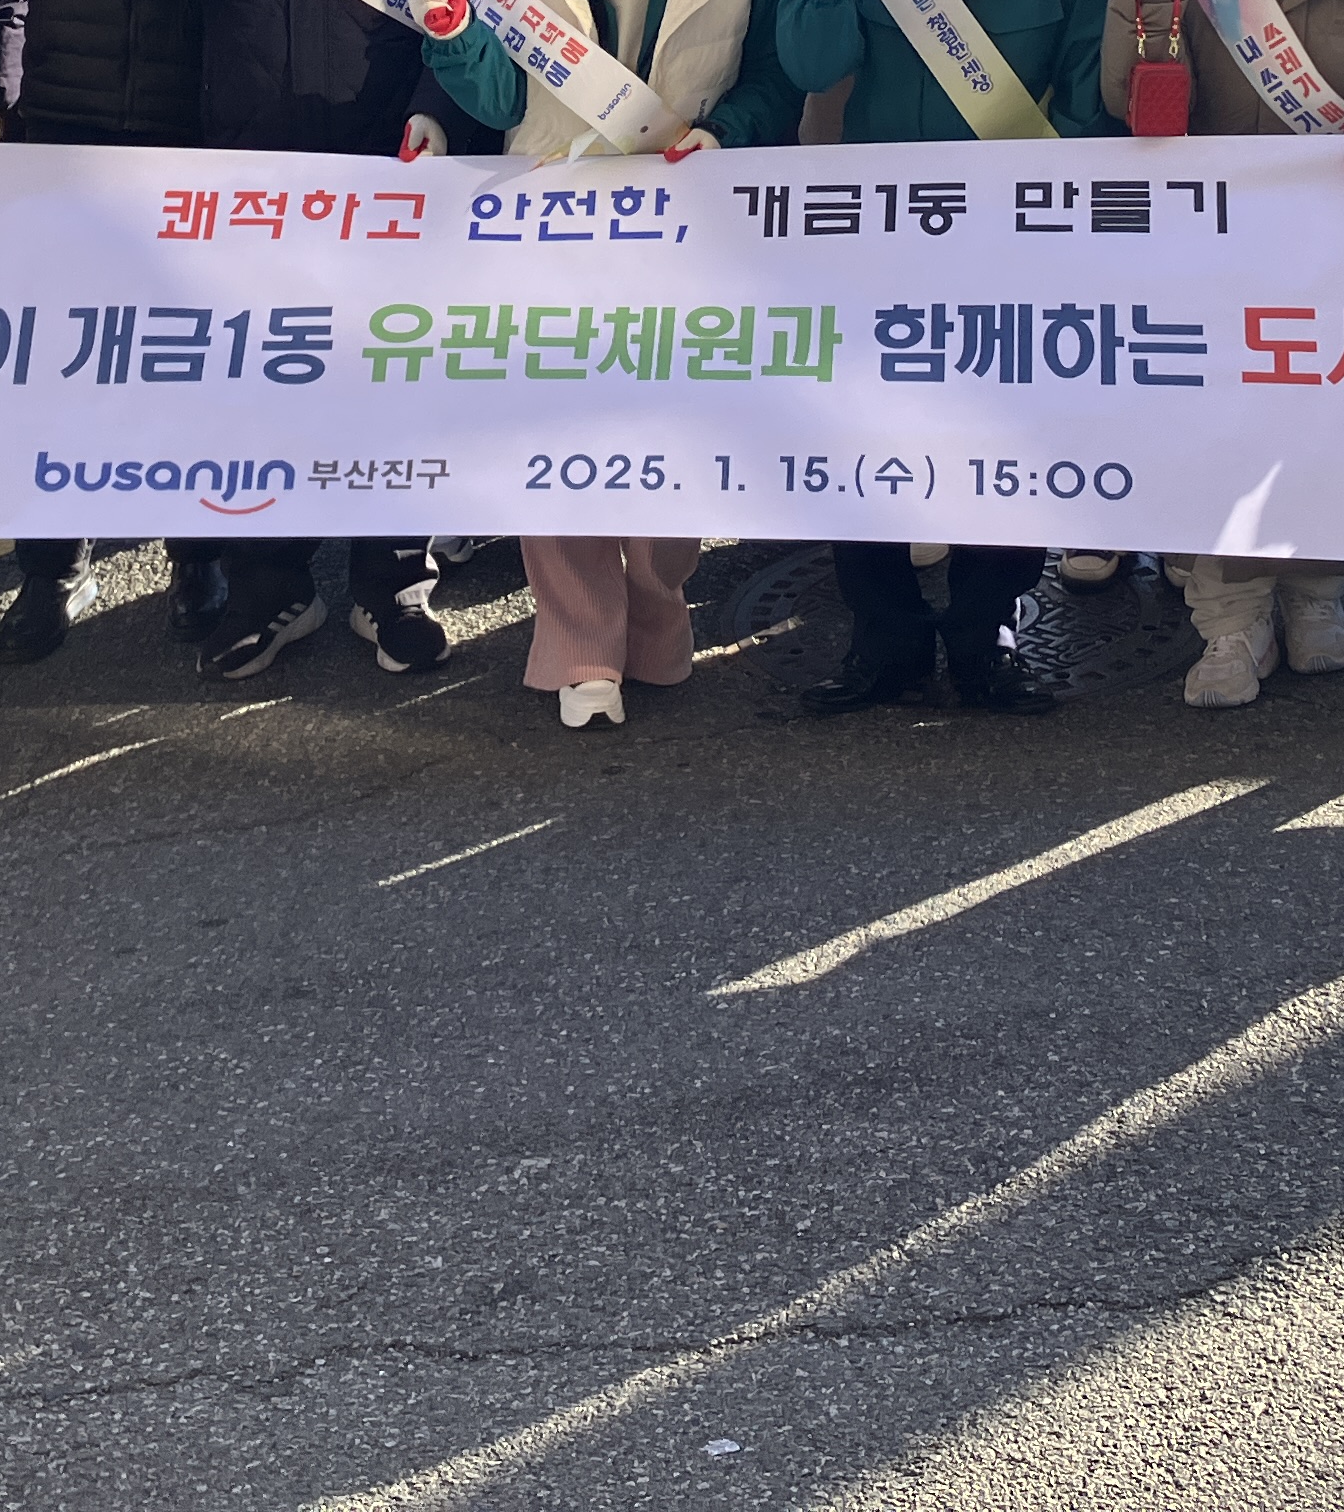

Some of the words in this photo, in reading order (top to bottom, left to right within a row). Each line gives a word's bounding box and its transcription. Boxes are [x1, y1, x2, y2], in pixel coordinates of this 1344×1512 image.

[503, 26, 526, 53] 집
[527, 46, 572, 88] 앞에
[519, 5, 589, 66] 저녁에
[926, 12, 968, 61] 청렴한
[960, 58, 991, 92] 세상
[1236, 36, 1262, 65] 내
[1263, 22, 1321, 99] 쓰레기
[597, 83, 632, 121] busanjin
[157, 189, 425, 241] 쾌적하고
[468, 186, 688, 244] 안전한,
[733, 179, 966, 239] 개금1동
[1015, 179, 1230, 235] 만들기
[60, 302, 335, 385] 개금1동
[360, 302, 843, 384] 유관단체원과
[873, 301, 1207, 388] 함께하는
[34, 451, 294, 503] busanjin
[306, 457, 451, 491] 부산진구
[525, 453, 683, 492] 2025.
[719, 454, 746, 492] 1.
[779, 454, 936, 496] 15.(수)
[968, 456, 1133, 501] 15:00
